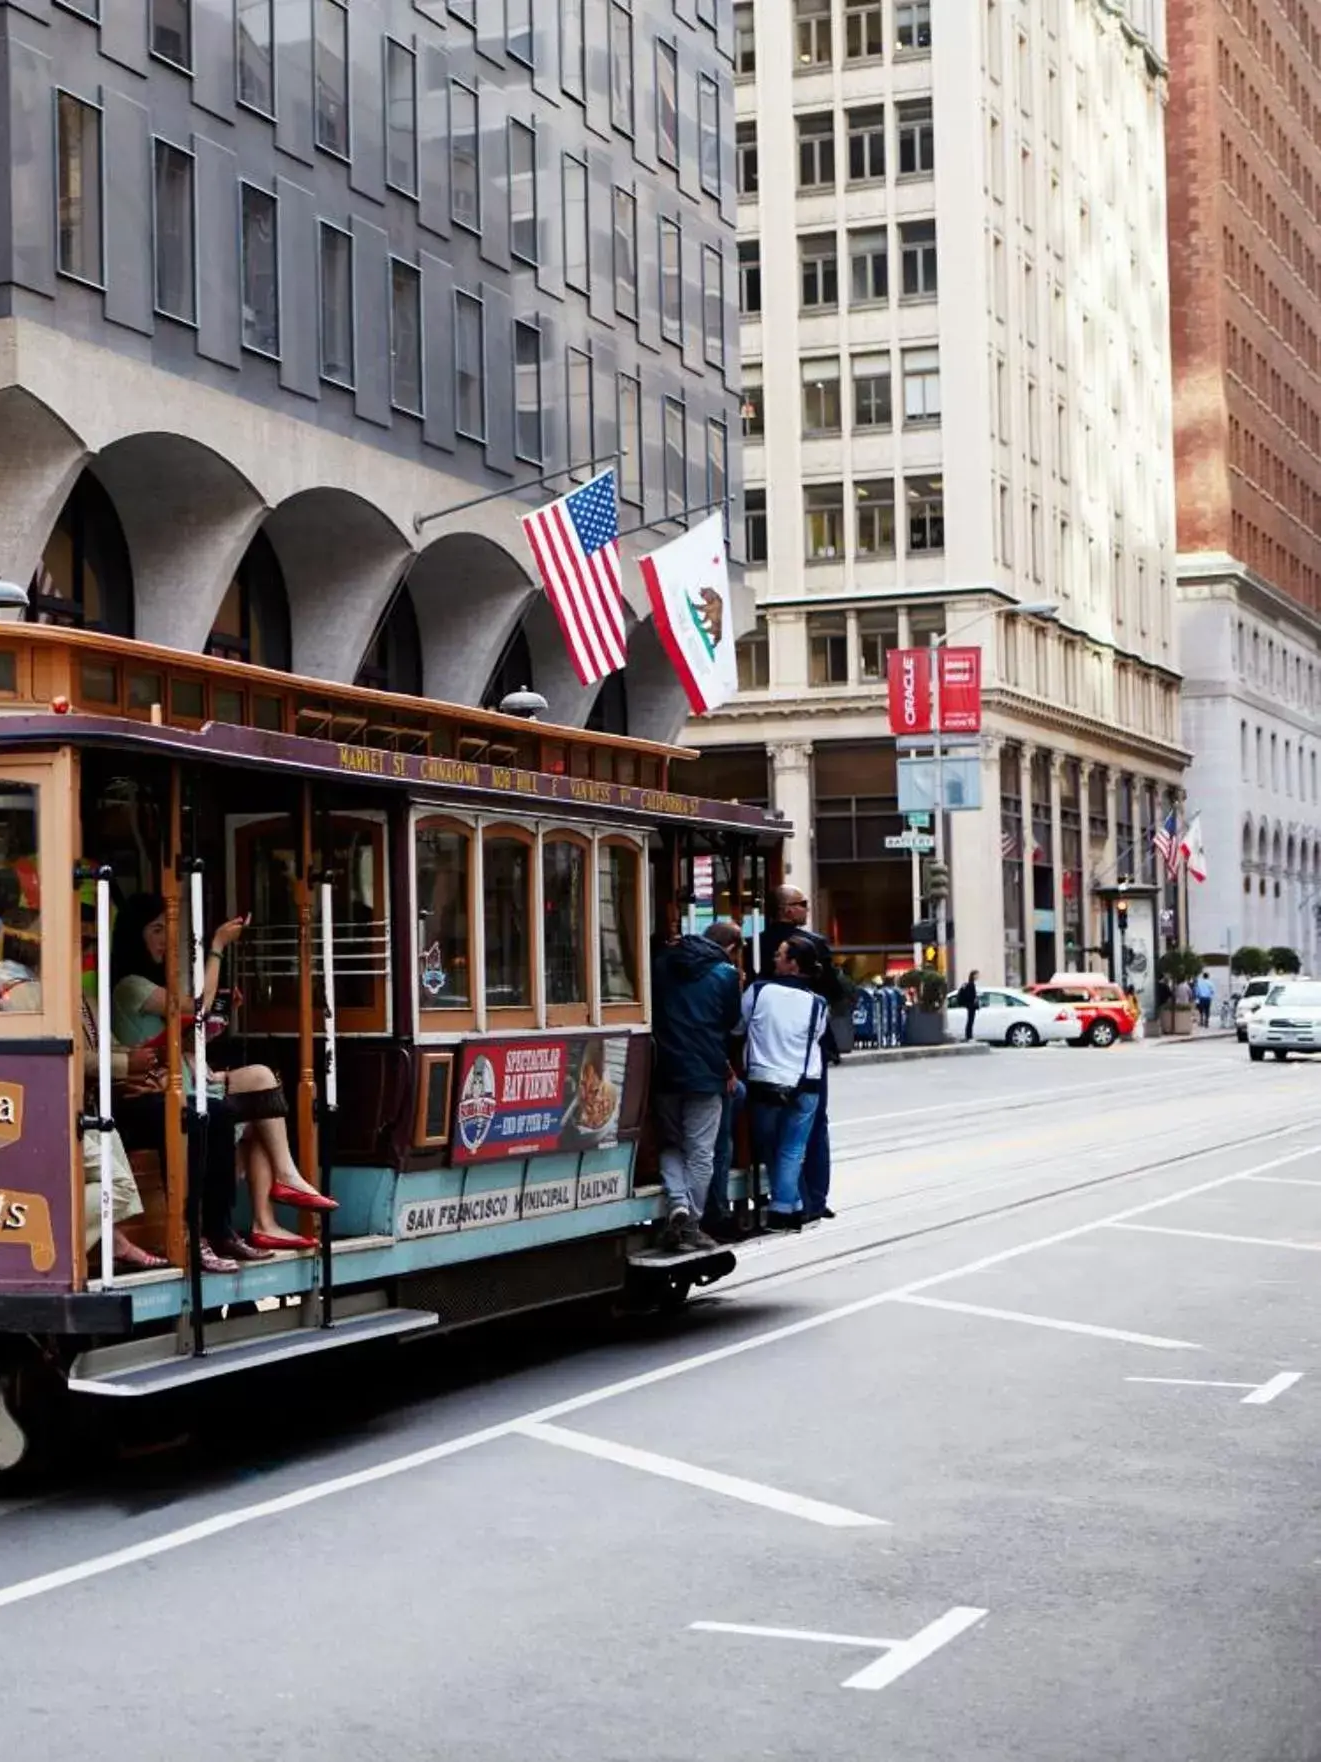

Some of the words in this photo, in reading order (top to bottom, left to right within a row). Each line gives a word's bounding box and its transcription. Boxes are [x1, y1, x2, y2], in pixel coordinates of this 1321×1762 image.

[904, 654, 916, 726] ORACLE
[340, 745, 384, 773] MARKET
[420, 759, 478, 785] CHINATOWN
[492, 767, 511, 789] NOB
[517, 771, 538, 794] HILL
[640, 792, 688, 814] CALIFORNIA
[406, 1208, 434, 1232] SAN
[437, 1195, 508, 1227] FRANCISCO
[513, 1185, 570, 1213] MUNICIPAL
[580, 1176, 620, 1201] RAILWAY
